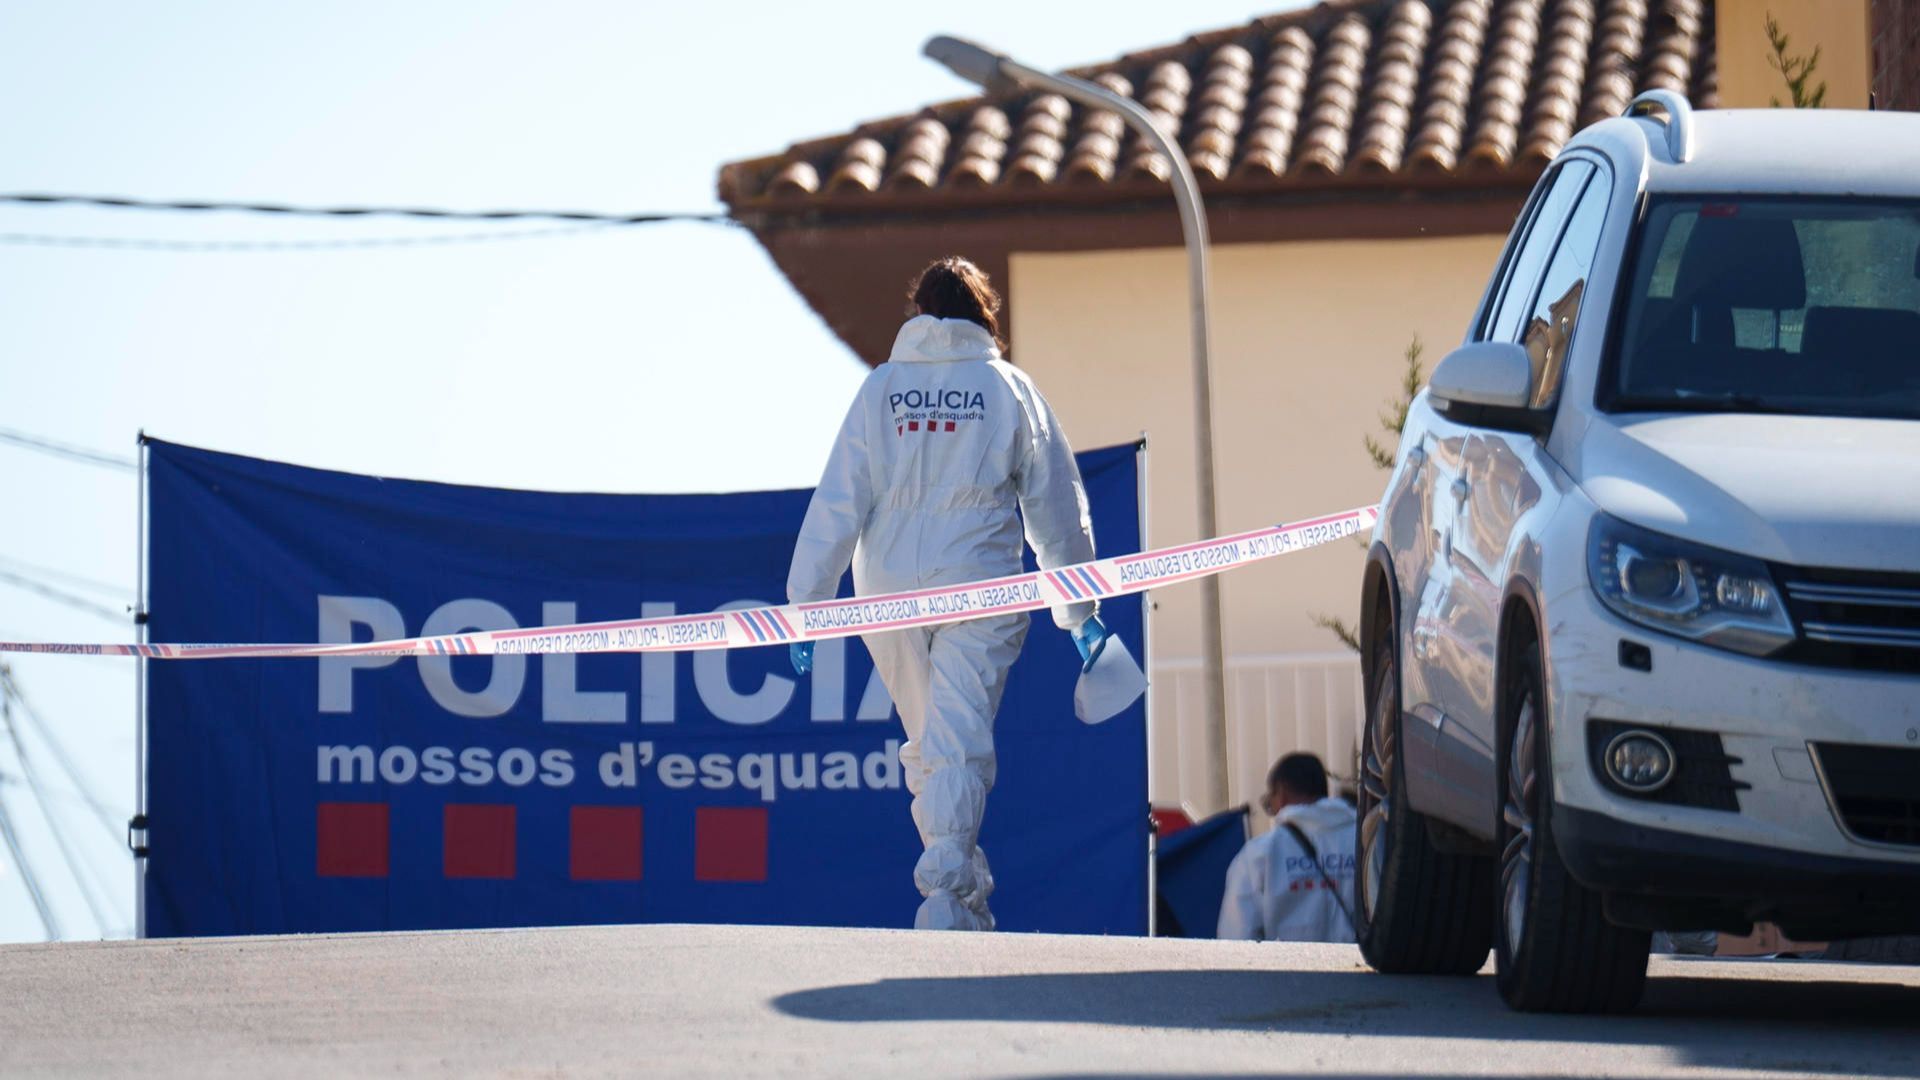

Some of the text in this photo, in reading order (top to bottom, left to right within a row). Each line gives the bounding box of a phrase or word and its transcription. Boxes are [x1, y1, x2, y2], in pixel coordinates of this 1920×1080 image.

[889, 389, 985, 413] POLICIA
[318, 594, 894, 724] POLICI
[317, 740, 900, 803] mossos d'esquad
